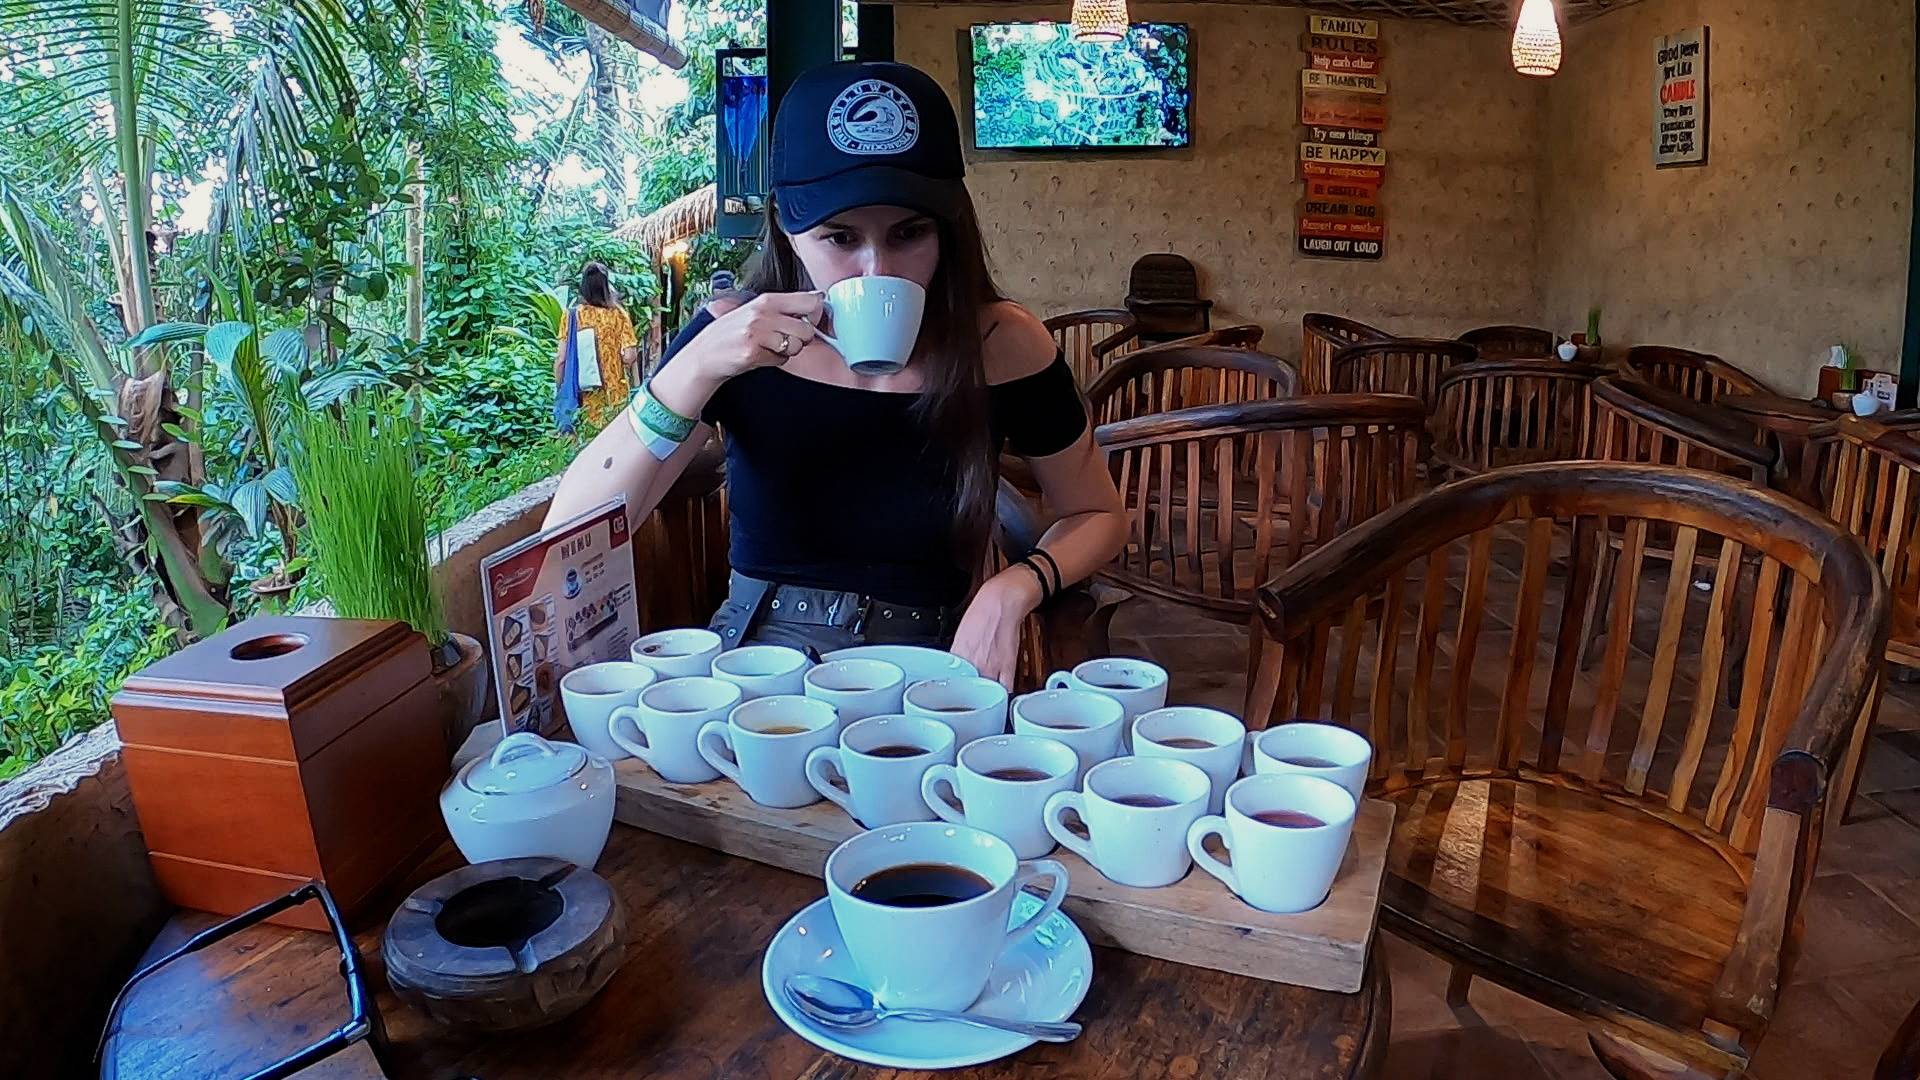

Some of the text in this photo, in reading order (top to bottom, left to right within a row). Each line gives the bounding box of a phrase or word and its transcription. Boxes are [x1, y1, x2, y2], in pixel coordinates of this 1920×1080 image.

[1320, 18, 1367, 34] FAMILY
[1311, 36, 1377, 53] RULES
[1308, 72, 1320, 85] BE
[1312, 126, 1327, 142] Try
[1347, 127, 1374, 146] things
[1306, 145, 1380, 162] BE HAPPY
[1305, 202, 1376, 217] DREAM BIG
[1303, 238, 1378, 254] LAUGH OUT LOUD
